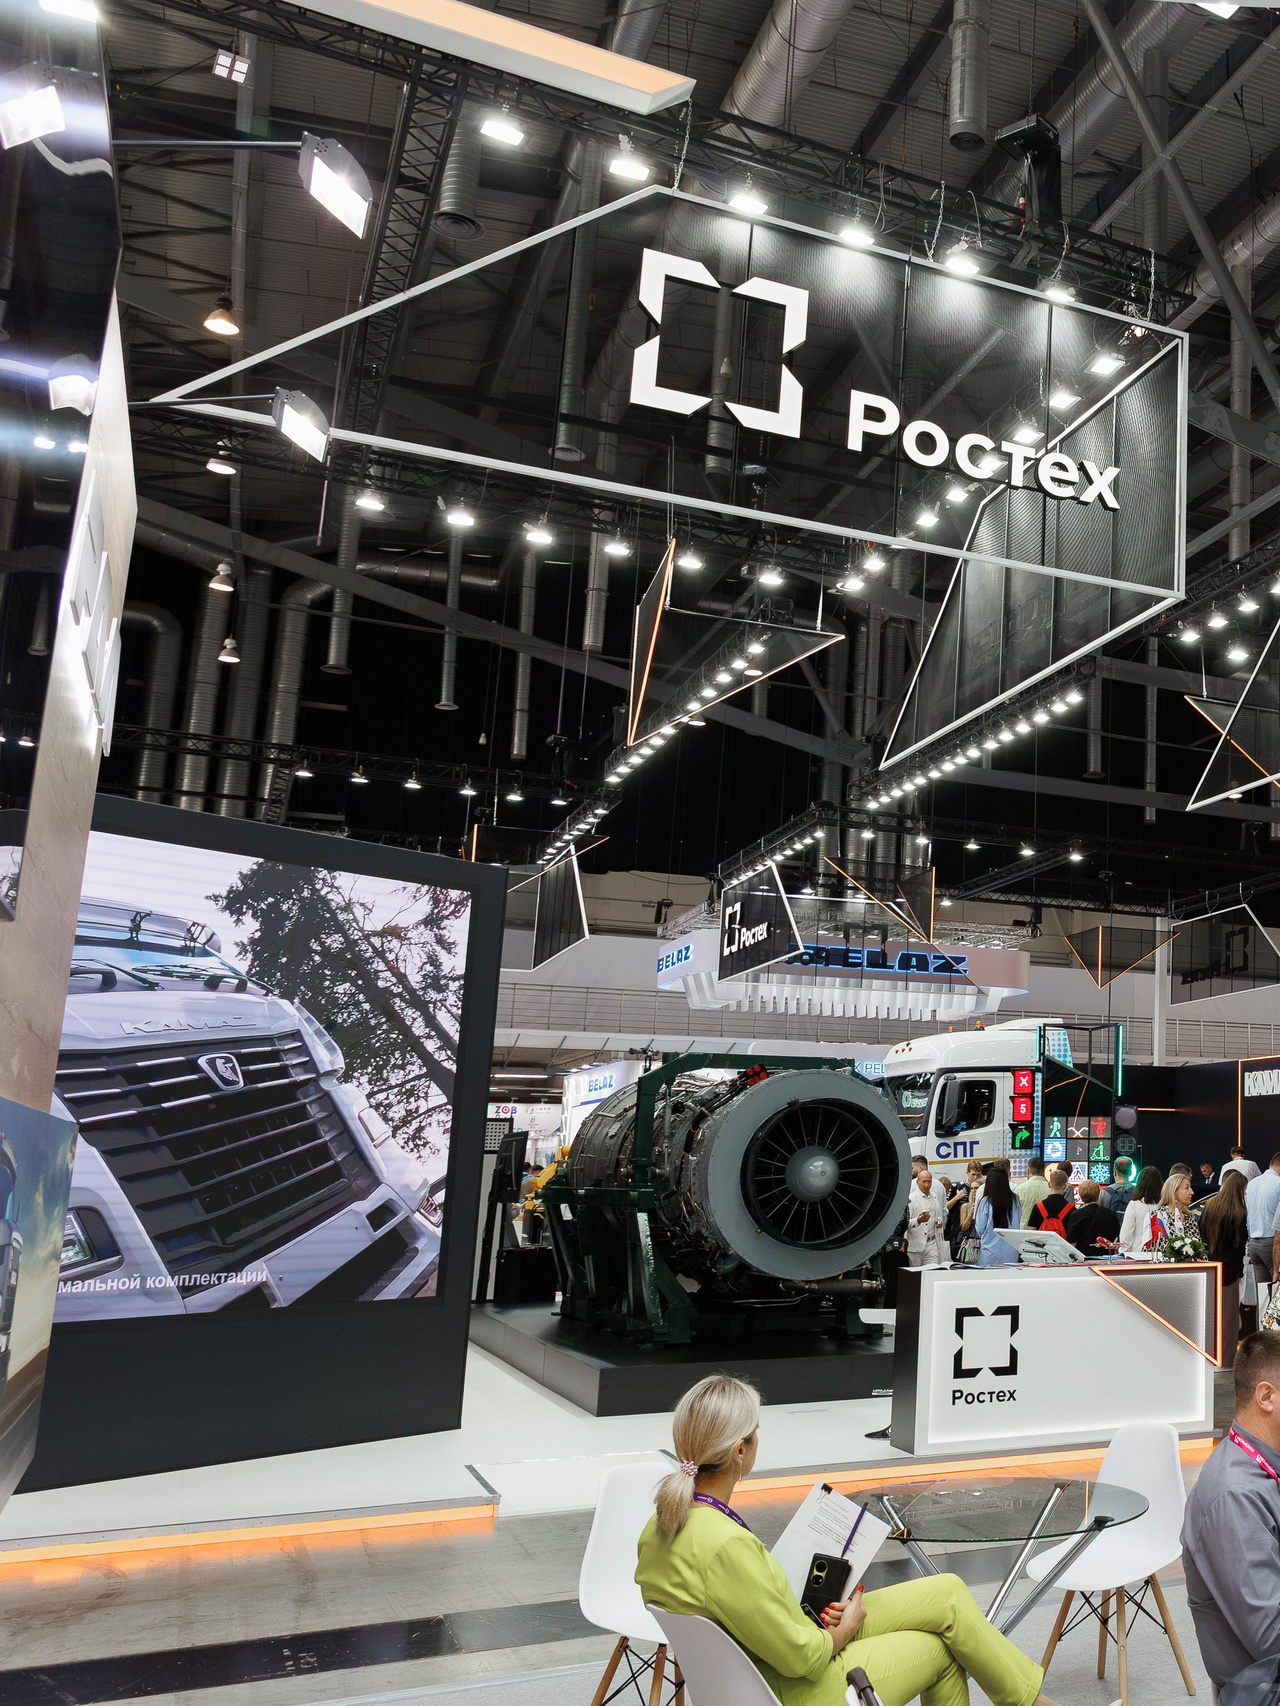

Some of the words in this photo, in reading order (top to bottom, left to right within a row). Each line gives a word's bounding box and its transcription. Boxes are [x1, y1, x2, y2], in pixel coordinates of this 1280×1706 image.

[846, 390, 1121, 510] Ростех
[740, 921, 769, 950] Ростех
[656, 943, 693, 974] BELAZ
[119, 1016, 257, 1035] KAMAZ
[588, 1074, 614, 1093] BELAZ
[1019, 1103, 1027, 1115] 5
[935, 1140, 980, 1160] СПГ
[146, 1269, 268, 1290] комплектации
[951, 1388, 1017, 1407] Ростех
